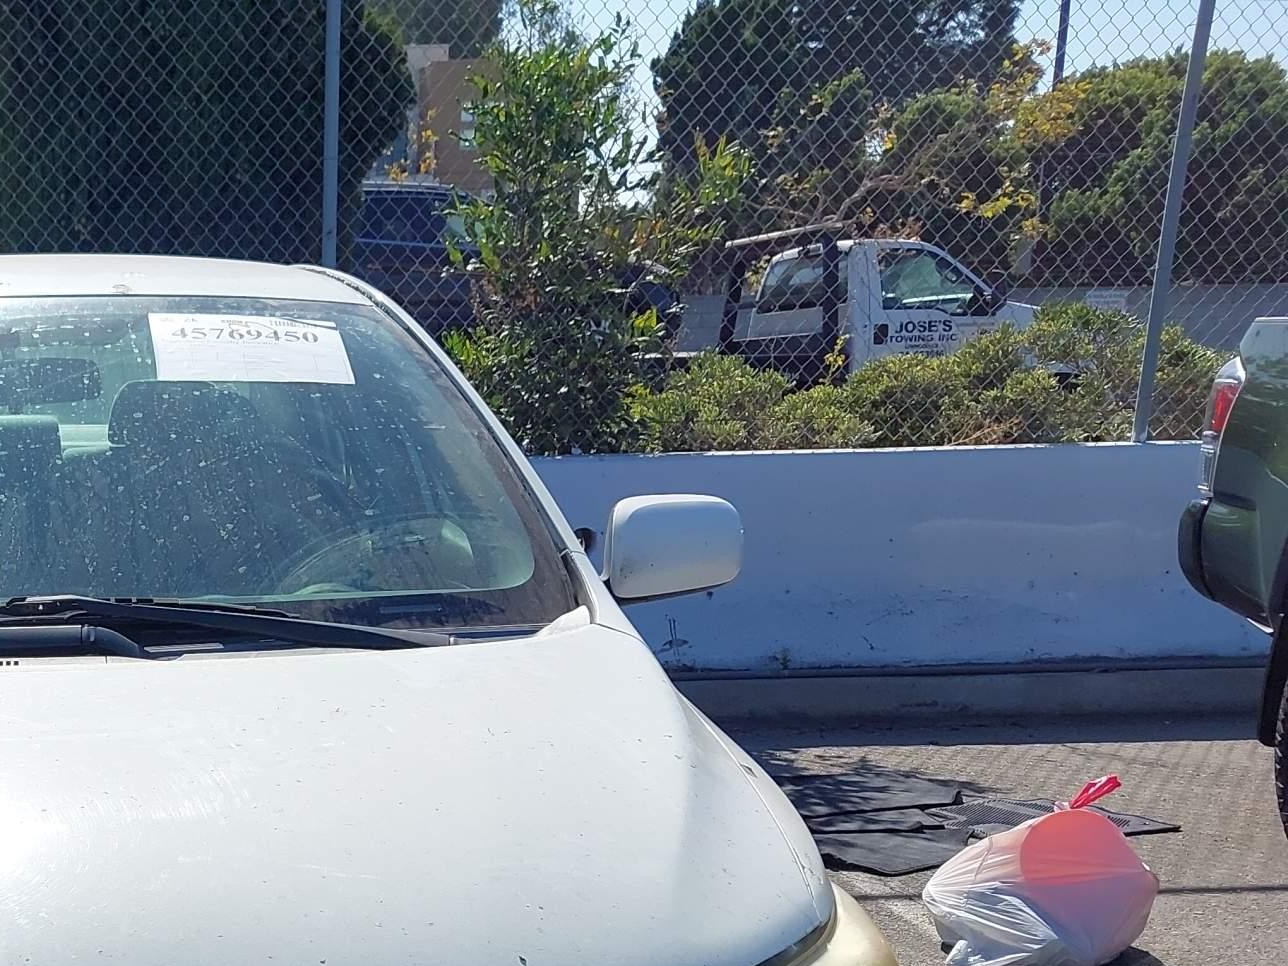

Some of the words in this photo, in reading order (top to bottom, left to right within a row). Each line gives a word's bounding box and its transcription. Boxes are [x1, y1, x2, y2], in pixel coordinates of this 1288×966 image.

[894, 319, 953, 334] JOSE'S
[170, 326, 319, 344] 45769450
[889, 334, 934, 344] TOWING
[938, 333, 958, 343] INC
